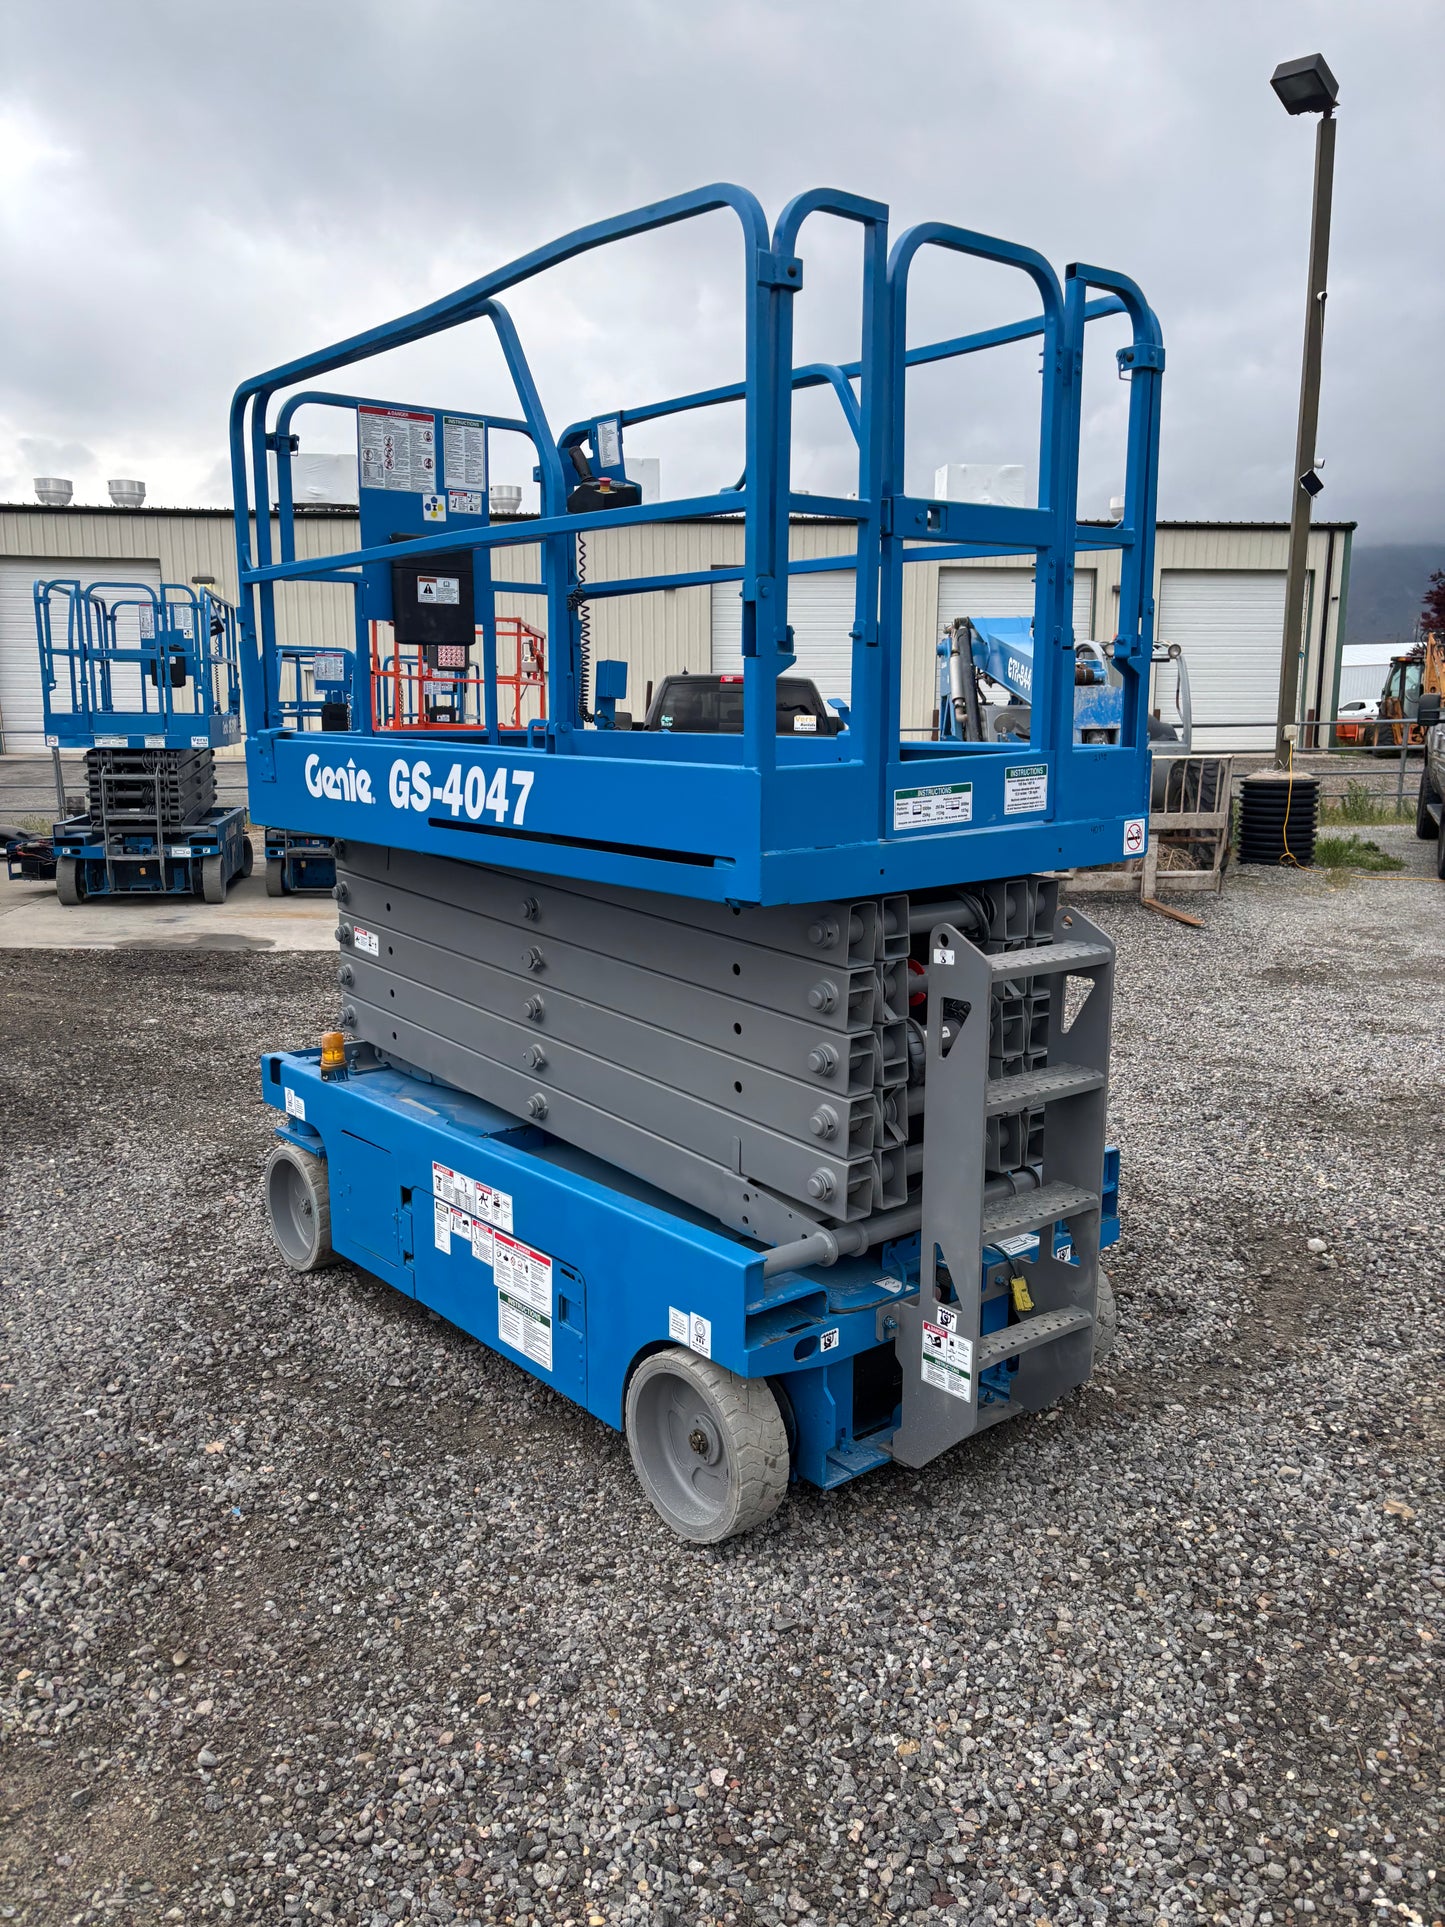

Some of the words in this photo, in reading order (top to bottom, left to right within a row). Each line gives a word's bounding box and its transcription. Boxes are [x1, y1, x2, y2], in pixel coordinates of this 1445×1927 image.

[447, 418, 480, 428] INSTRUCTIONS
[1010, 767, 1044, 777] INSTRUCTIONS
[304, 753, 373, 804] Genie
[388, 758, 535, 826] GS-4047
[917, 786, 952, 797] INSTRUCTIONS
[517, 1243, 531, 1255] DANGER
[507, 1296, 542, 1322] INSTRUCTIONS
[930, 1326, 946, 1336] DANGER
